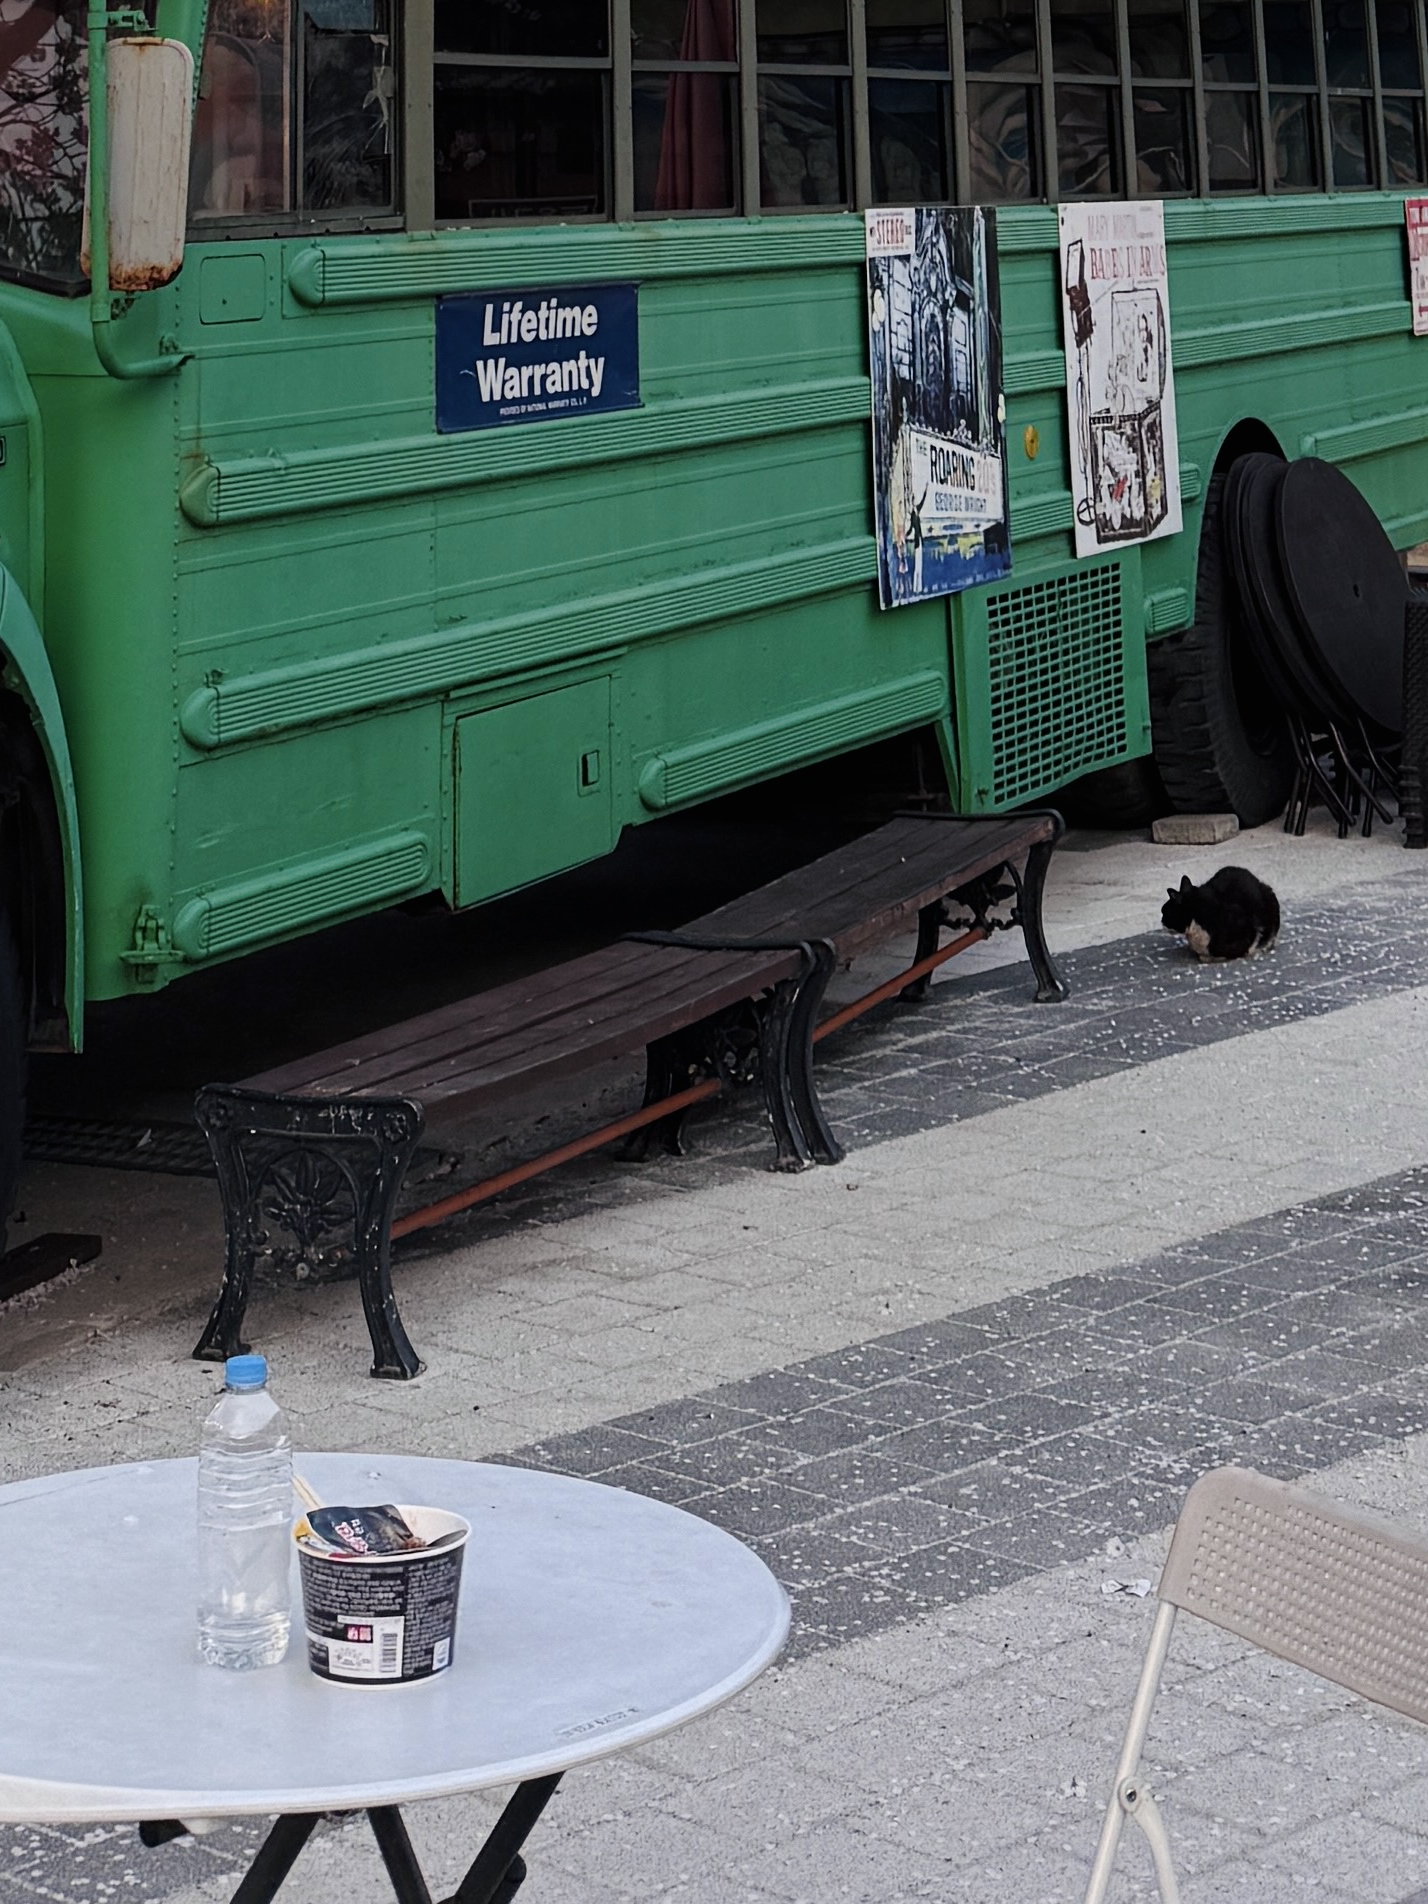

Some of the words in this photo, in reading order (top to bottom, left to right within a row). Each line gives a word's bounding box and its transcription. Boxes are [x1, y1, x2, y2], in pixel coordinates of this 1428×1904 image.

[876, 218, 904, 245] STEREO
[1090, 246, 1124, 280] BABES
[1126, 245, 1137, 278] IN
[1139, 244, 1166, 277] ARMS
[482, 297, 598, 346] Lifetime
[475, 350, 606, 403] Warranty
[916, 438, 927, 456] THE
[930, 444, 976, 492] ROARING
[935, 491, 963, 512] GEORGE
[964, 495, 987, 513] WRIGHT
